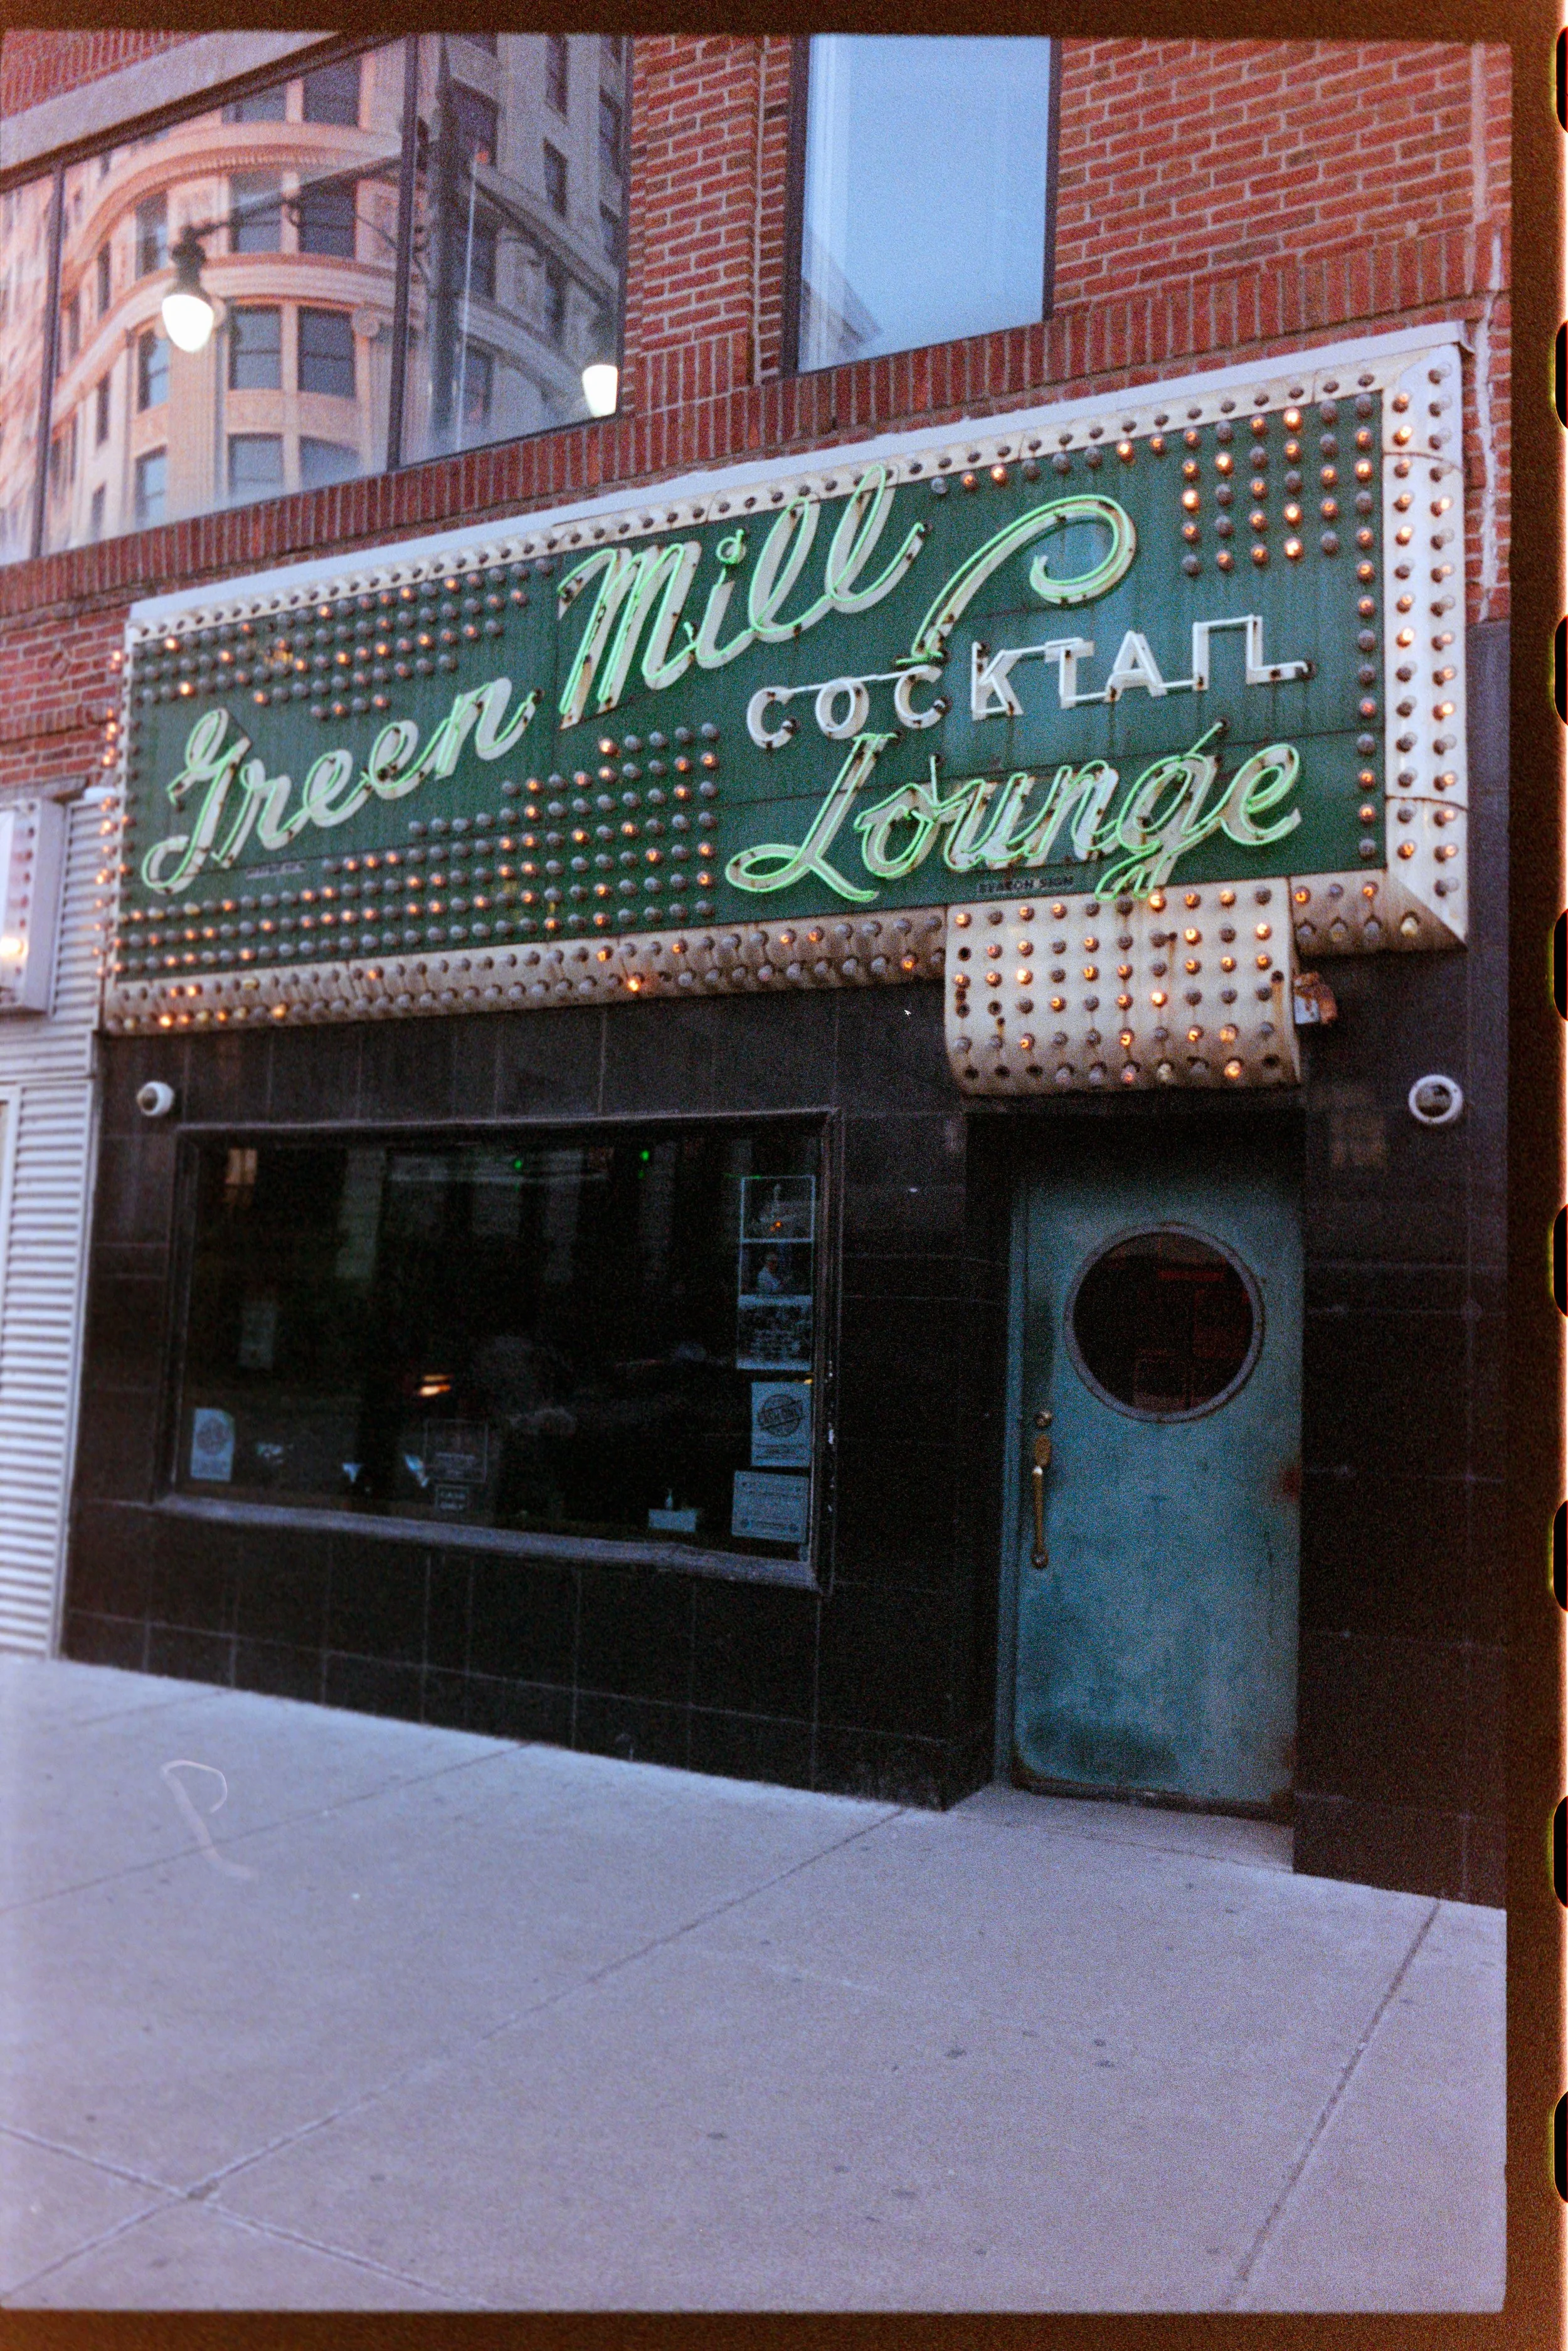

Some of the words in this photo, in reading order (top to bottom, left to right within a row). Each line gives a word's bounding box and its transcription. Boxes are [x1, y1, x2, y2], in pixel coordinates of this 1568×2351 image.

[142, 677, 544, 896] Green
[557, 464, 931, 730] Mill
[746, 614, 1316, 749] COCKTAIL
